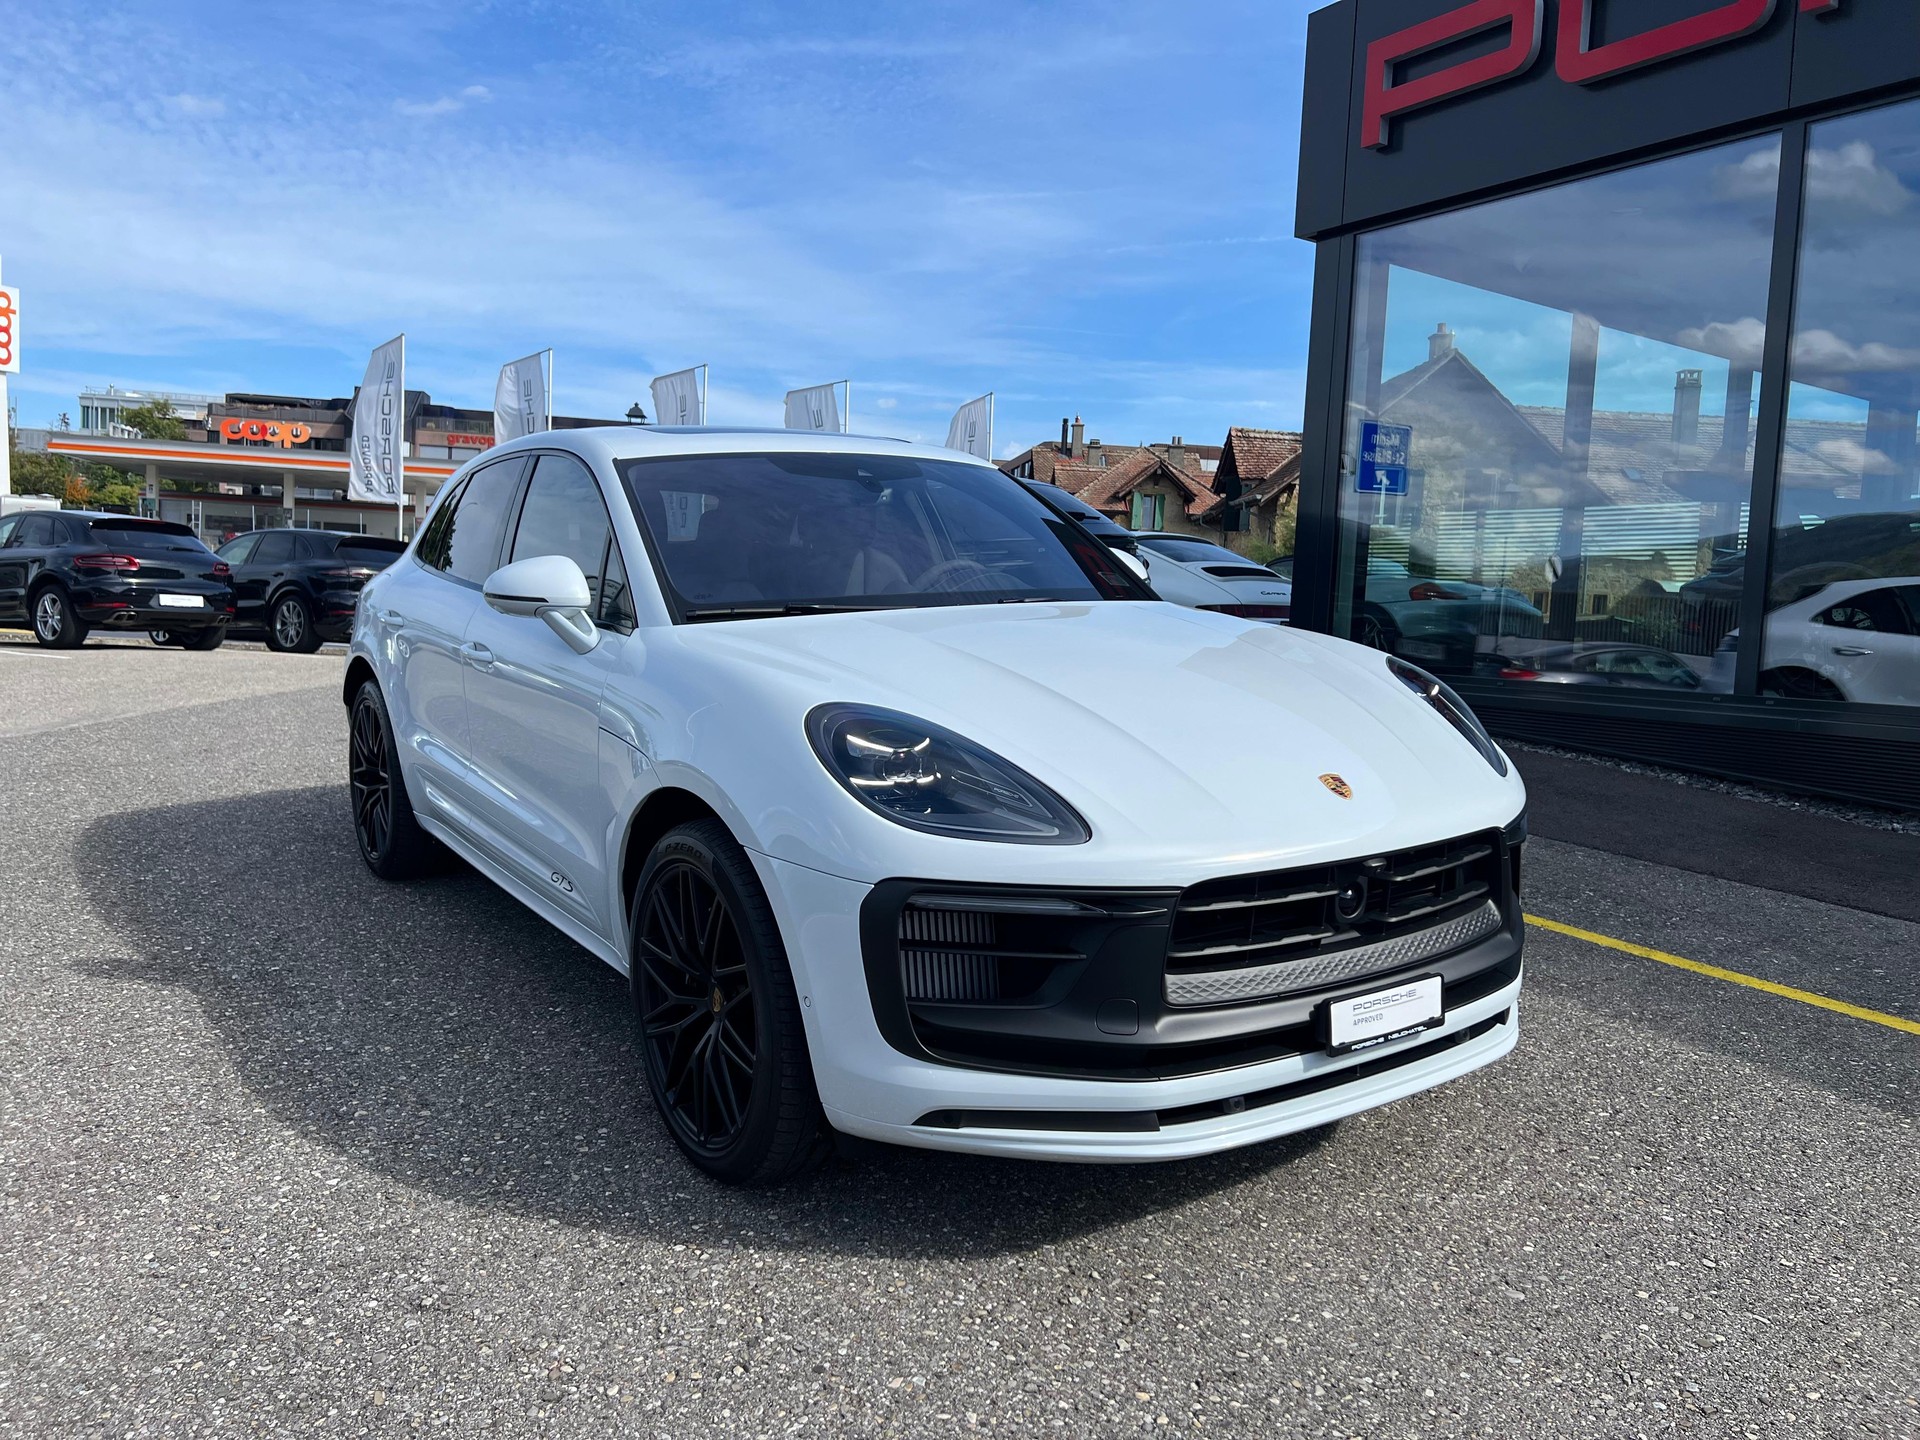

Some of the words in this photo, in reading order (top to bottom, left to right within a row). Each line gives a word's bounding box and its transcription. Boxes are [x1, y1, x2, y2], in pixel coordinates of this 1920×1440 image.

[220, 418, 311, 449] coop
[550, 871, 574, 893] GTS
[1352, 988, 1417, 1012] PORSCHE
[1353, 1013, 1384, 1026] APPROVED
[1351, 1037, 1385, 1051] PORSCHE
